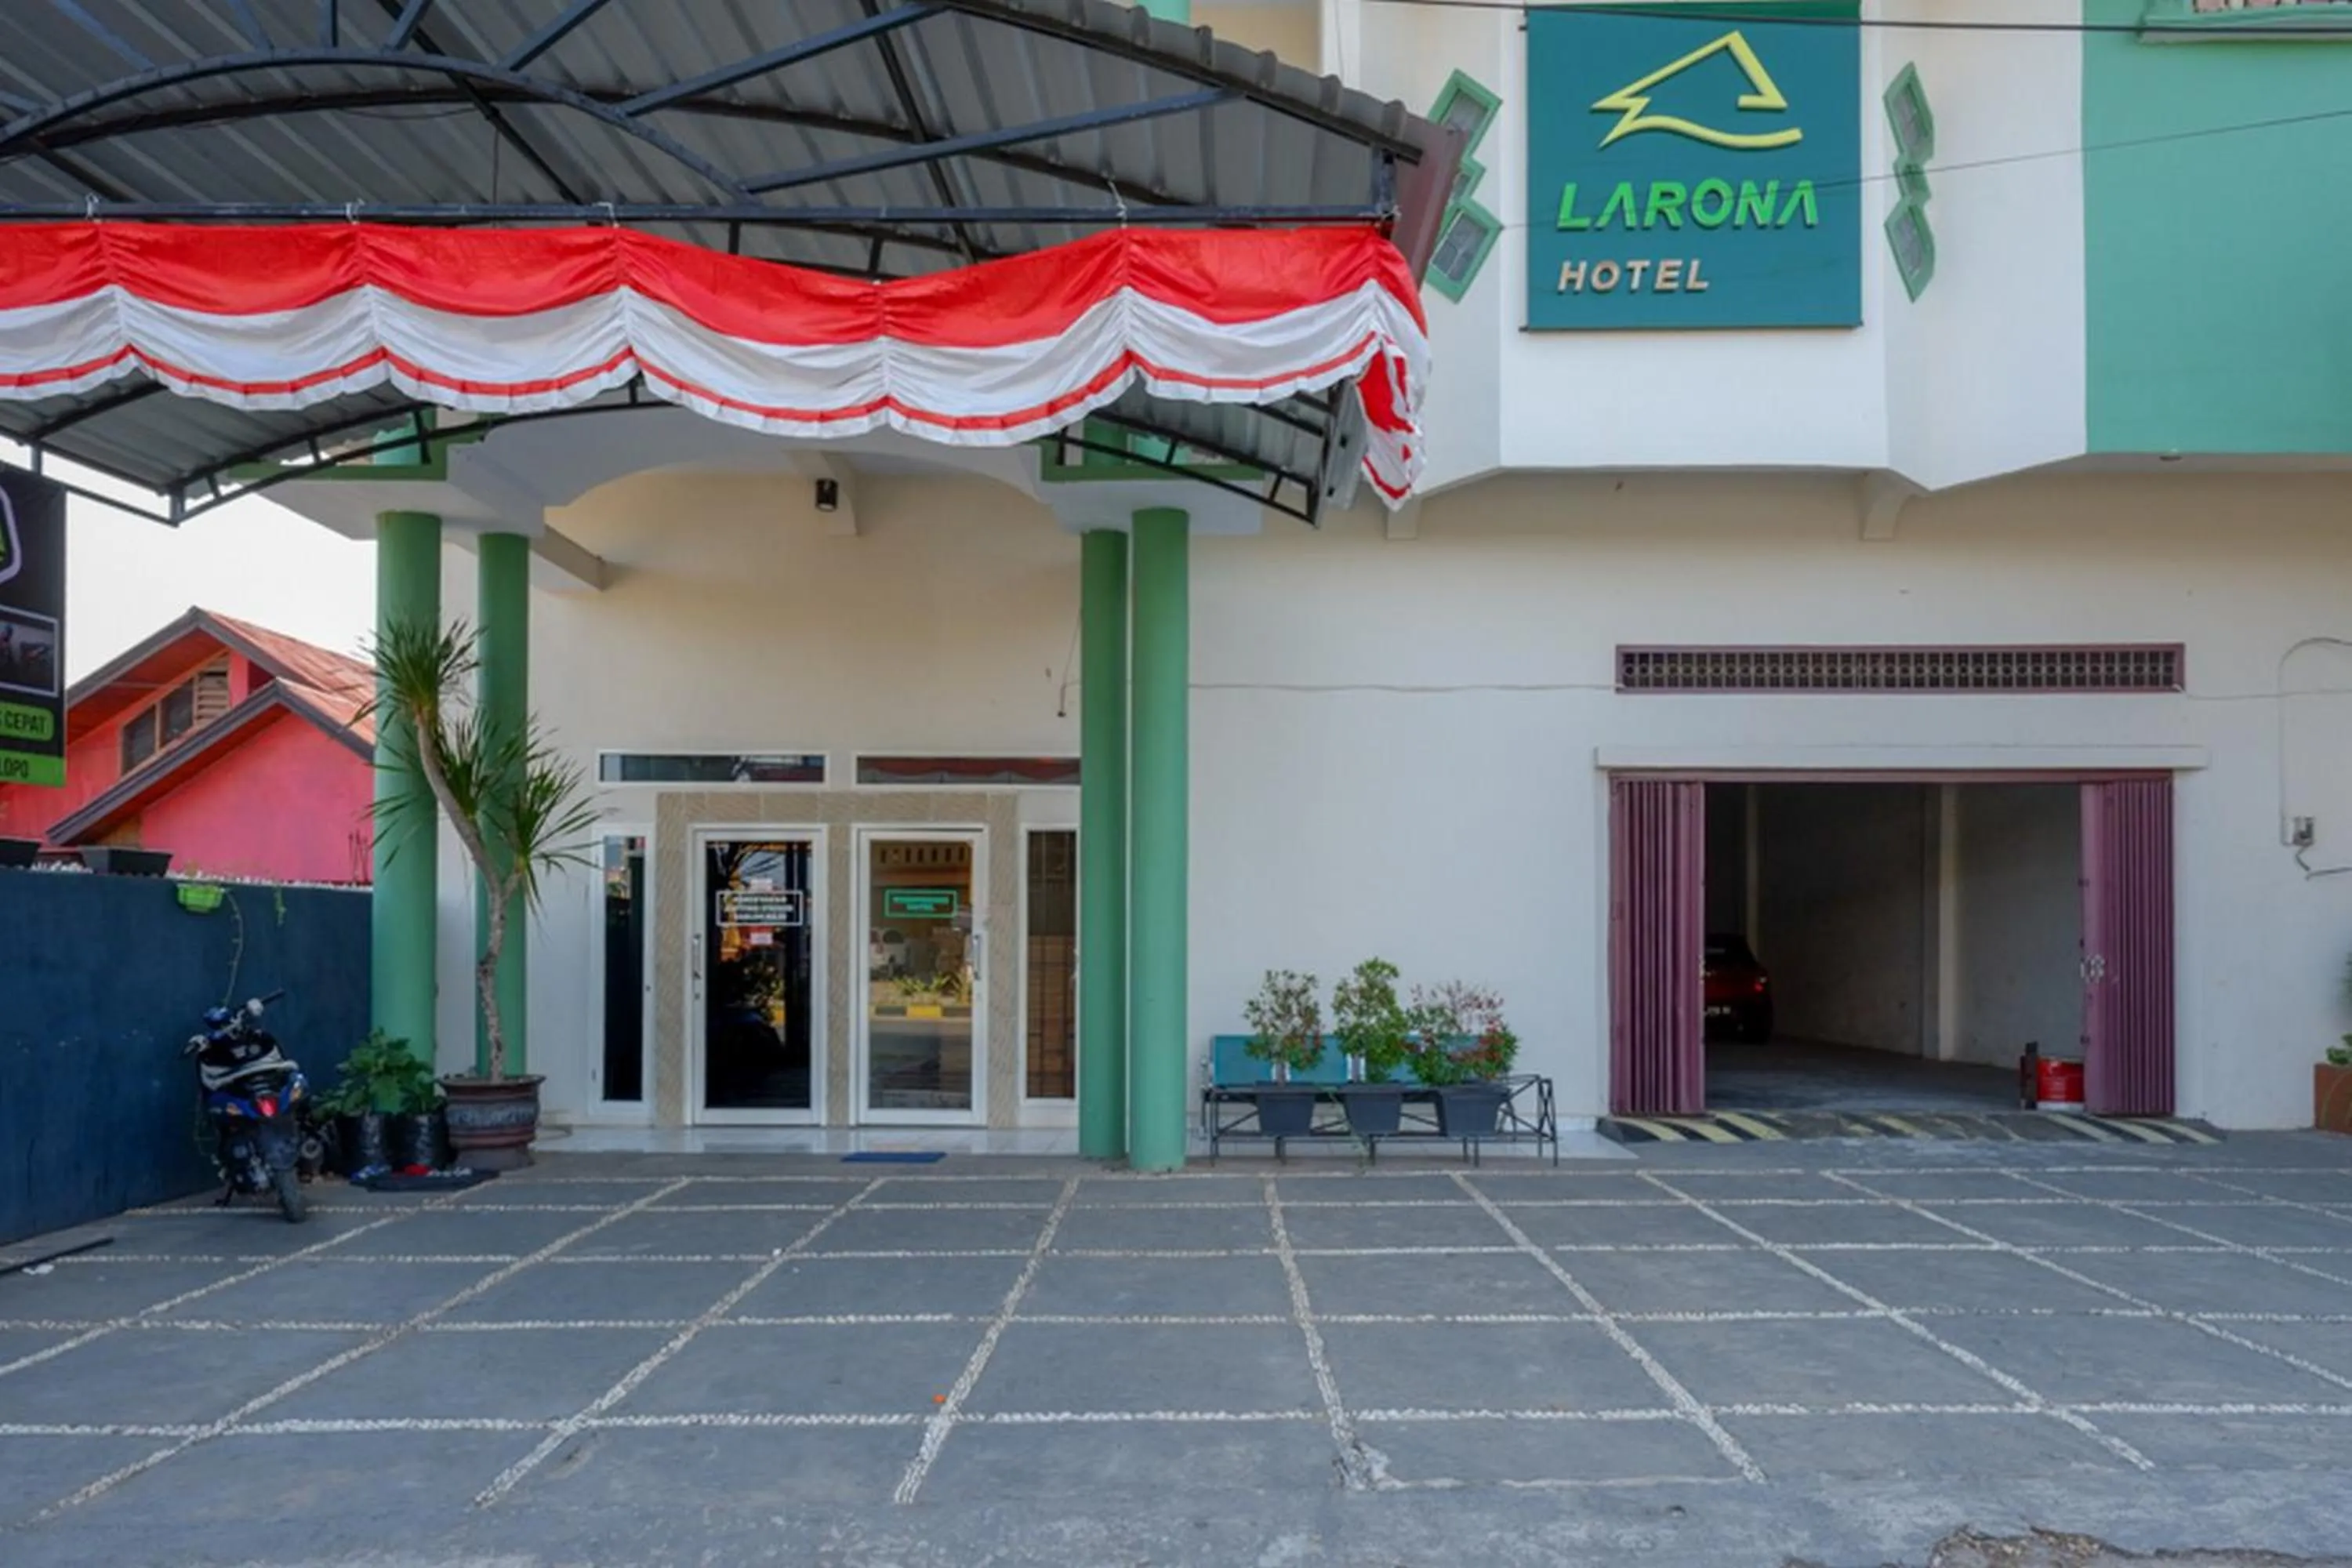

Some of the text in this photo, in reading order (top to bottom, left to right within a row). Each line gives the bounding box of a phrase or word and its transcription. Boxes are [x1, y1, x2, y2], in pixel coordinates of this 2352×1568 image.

[1556, 177, 1819, 228] LARONA
[1557, 259, 1710, 292] HOTEL
[5, 710, 47, 735] CEPAT
